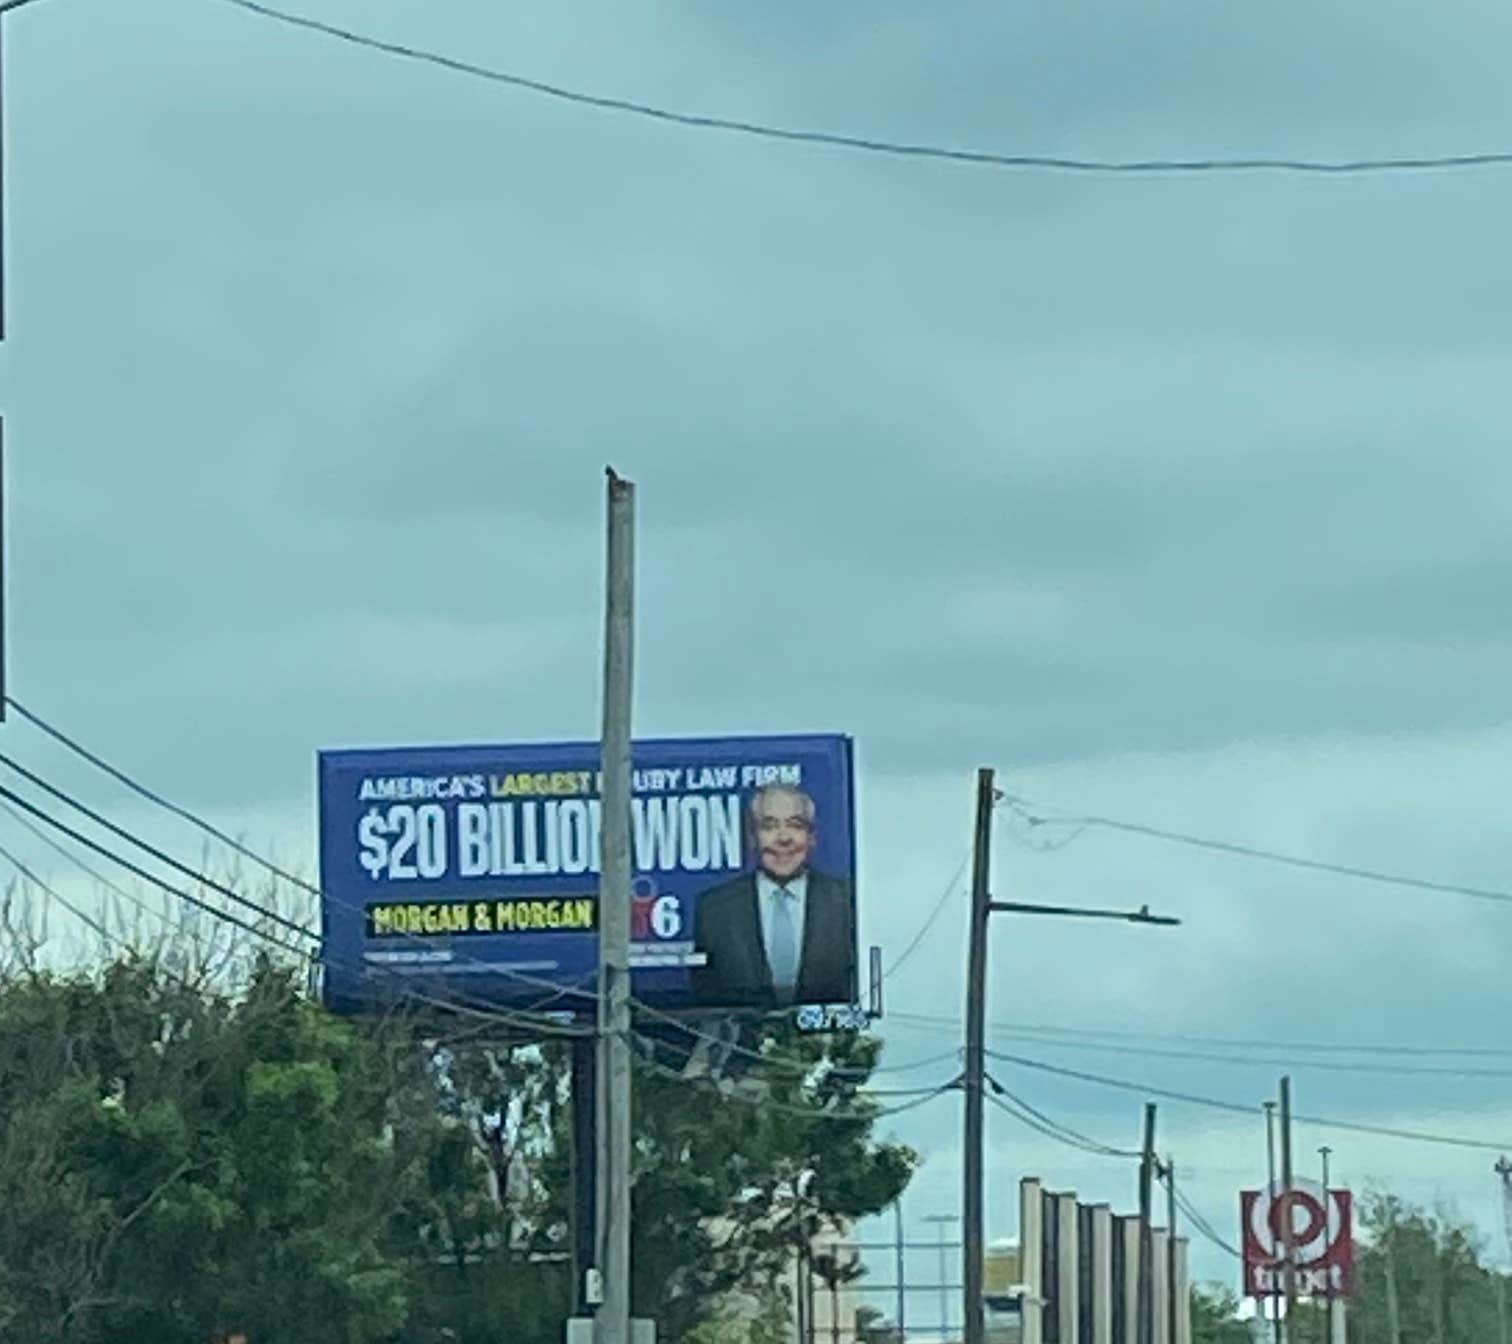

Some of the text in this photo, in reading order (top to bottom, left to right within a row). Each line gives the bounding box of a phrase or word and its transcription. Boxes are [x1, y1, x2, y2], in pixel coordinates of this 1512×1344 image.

[490, 771, 591, 797] LARGEST
[686, 765, 738, 790] LAW
[358, 805, 447, 881] $20
[630, 793, 742, 871] WON
[373, 899, 593, 935] MORGAN & MORGAN
